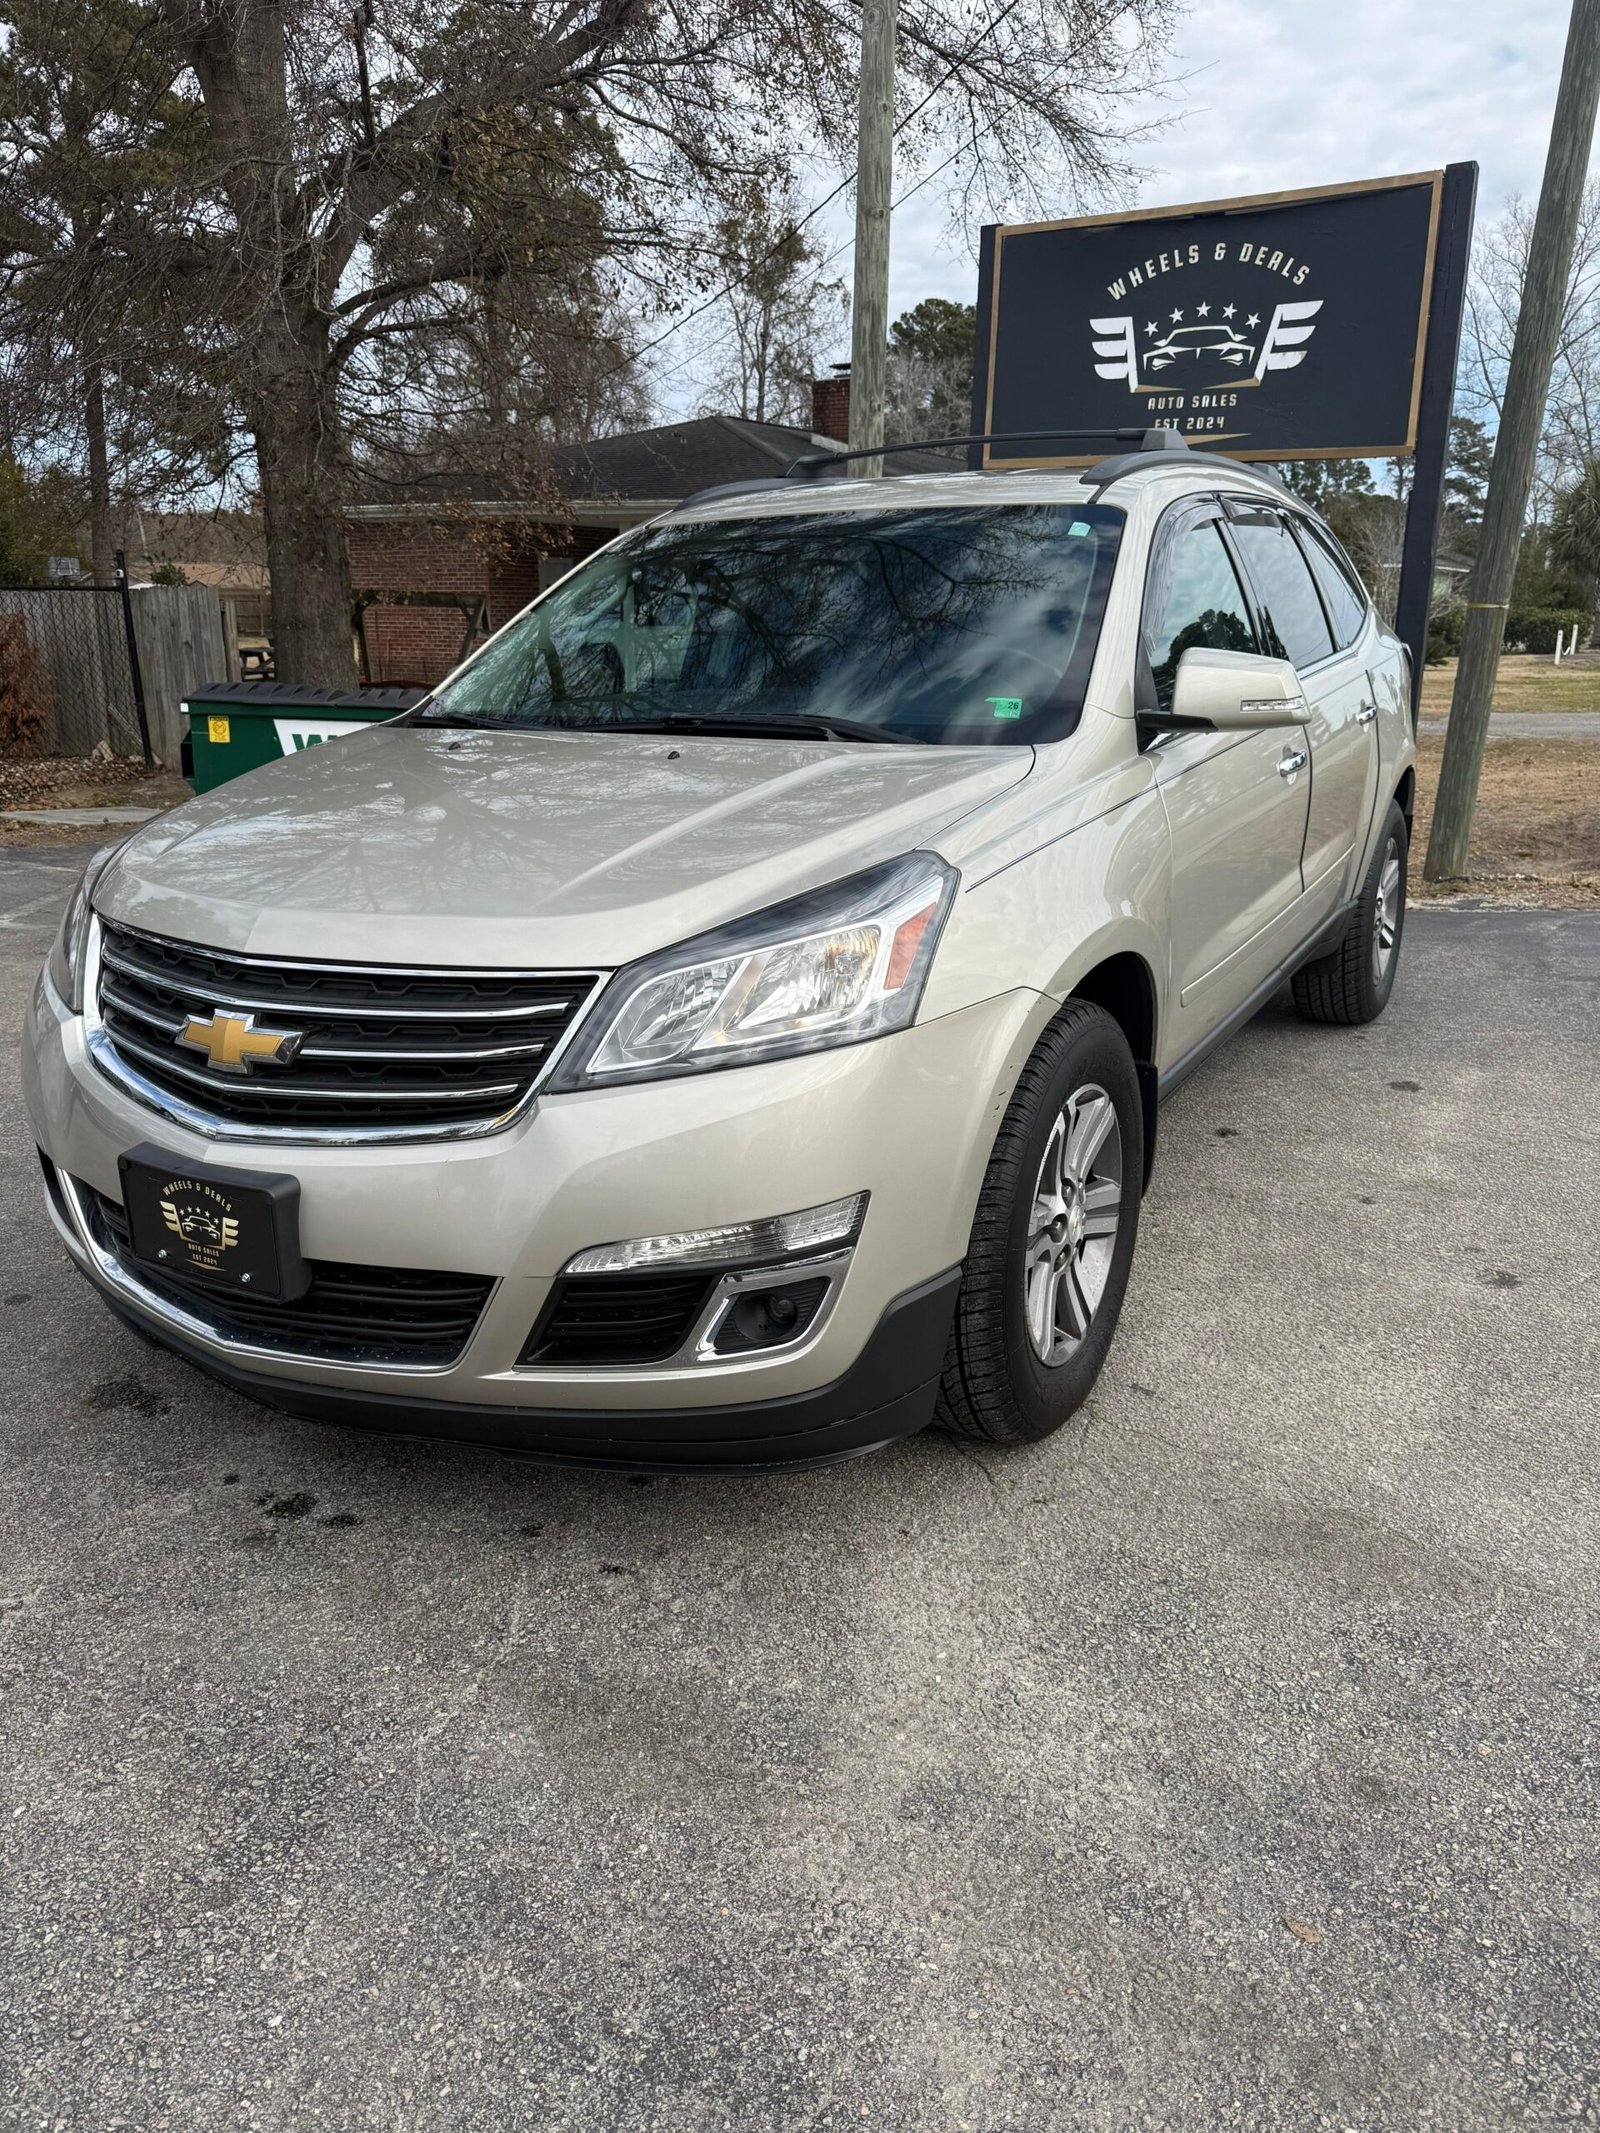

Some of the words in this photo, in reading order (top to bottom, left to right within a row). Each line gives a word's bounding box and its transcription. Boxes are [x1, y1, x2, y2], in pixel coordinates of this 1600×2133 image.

[1107, 244, 1199, 300] WHEELS
[1214, 243, 1226, 260] &
[1239, 243, 1311, 285] DEALS
[1147, 396, 1184, 410] AUTO
[1191, 394, 1238, 408] SALES
[1155, 418, 1180, 430] EST
[1186, 416, 1225, 430] 2024
[1008, 701, 1019, 710] 26
[163, 1180, 192, 1196] WHEELS
[205, 1186, 232, 1212] DEALS
[188, 1242, 201, 1252] AUTO
[192, 1253, 202, 1261] EST
[203, 1256, 218, 1266] 2024
